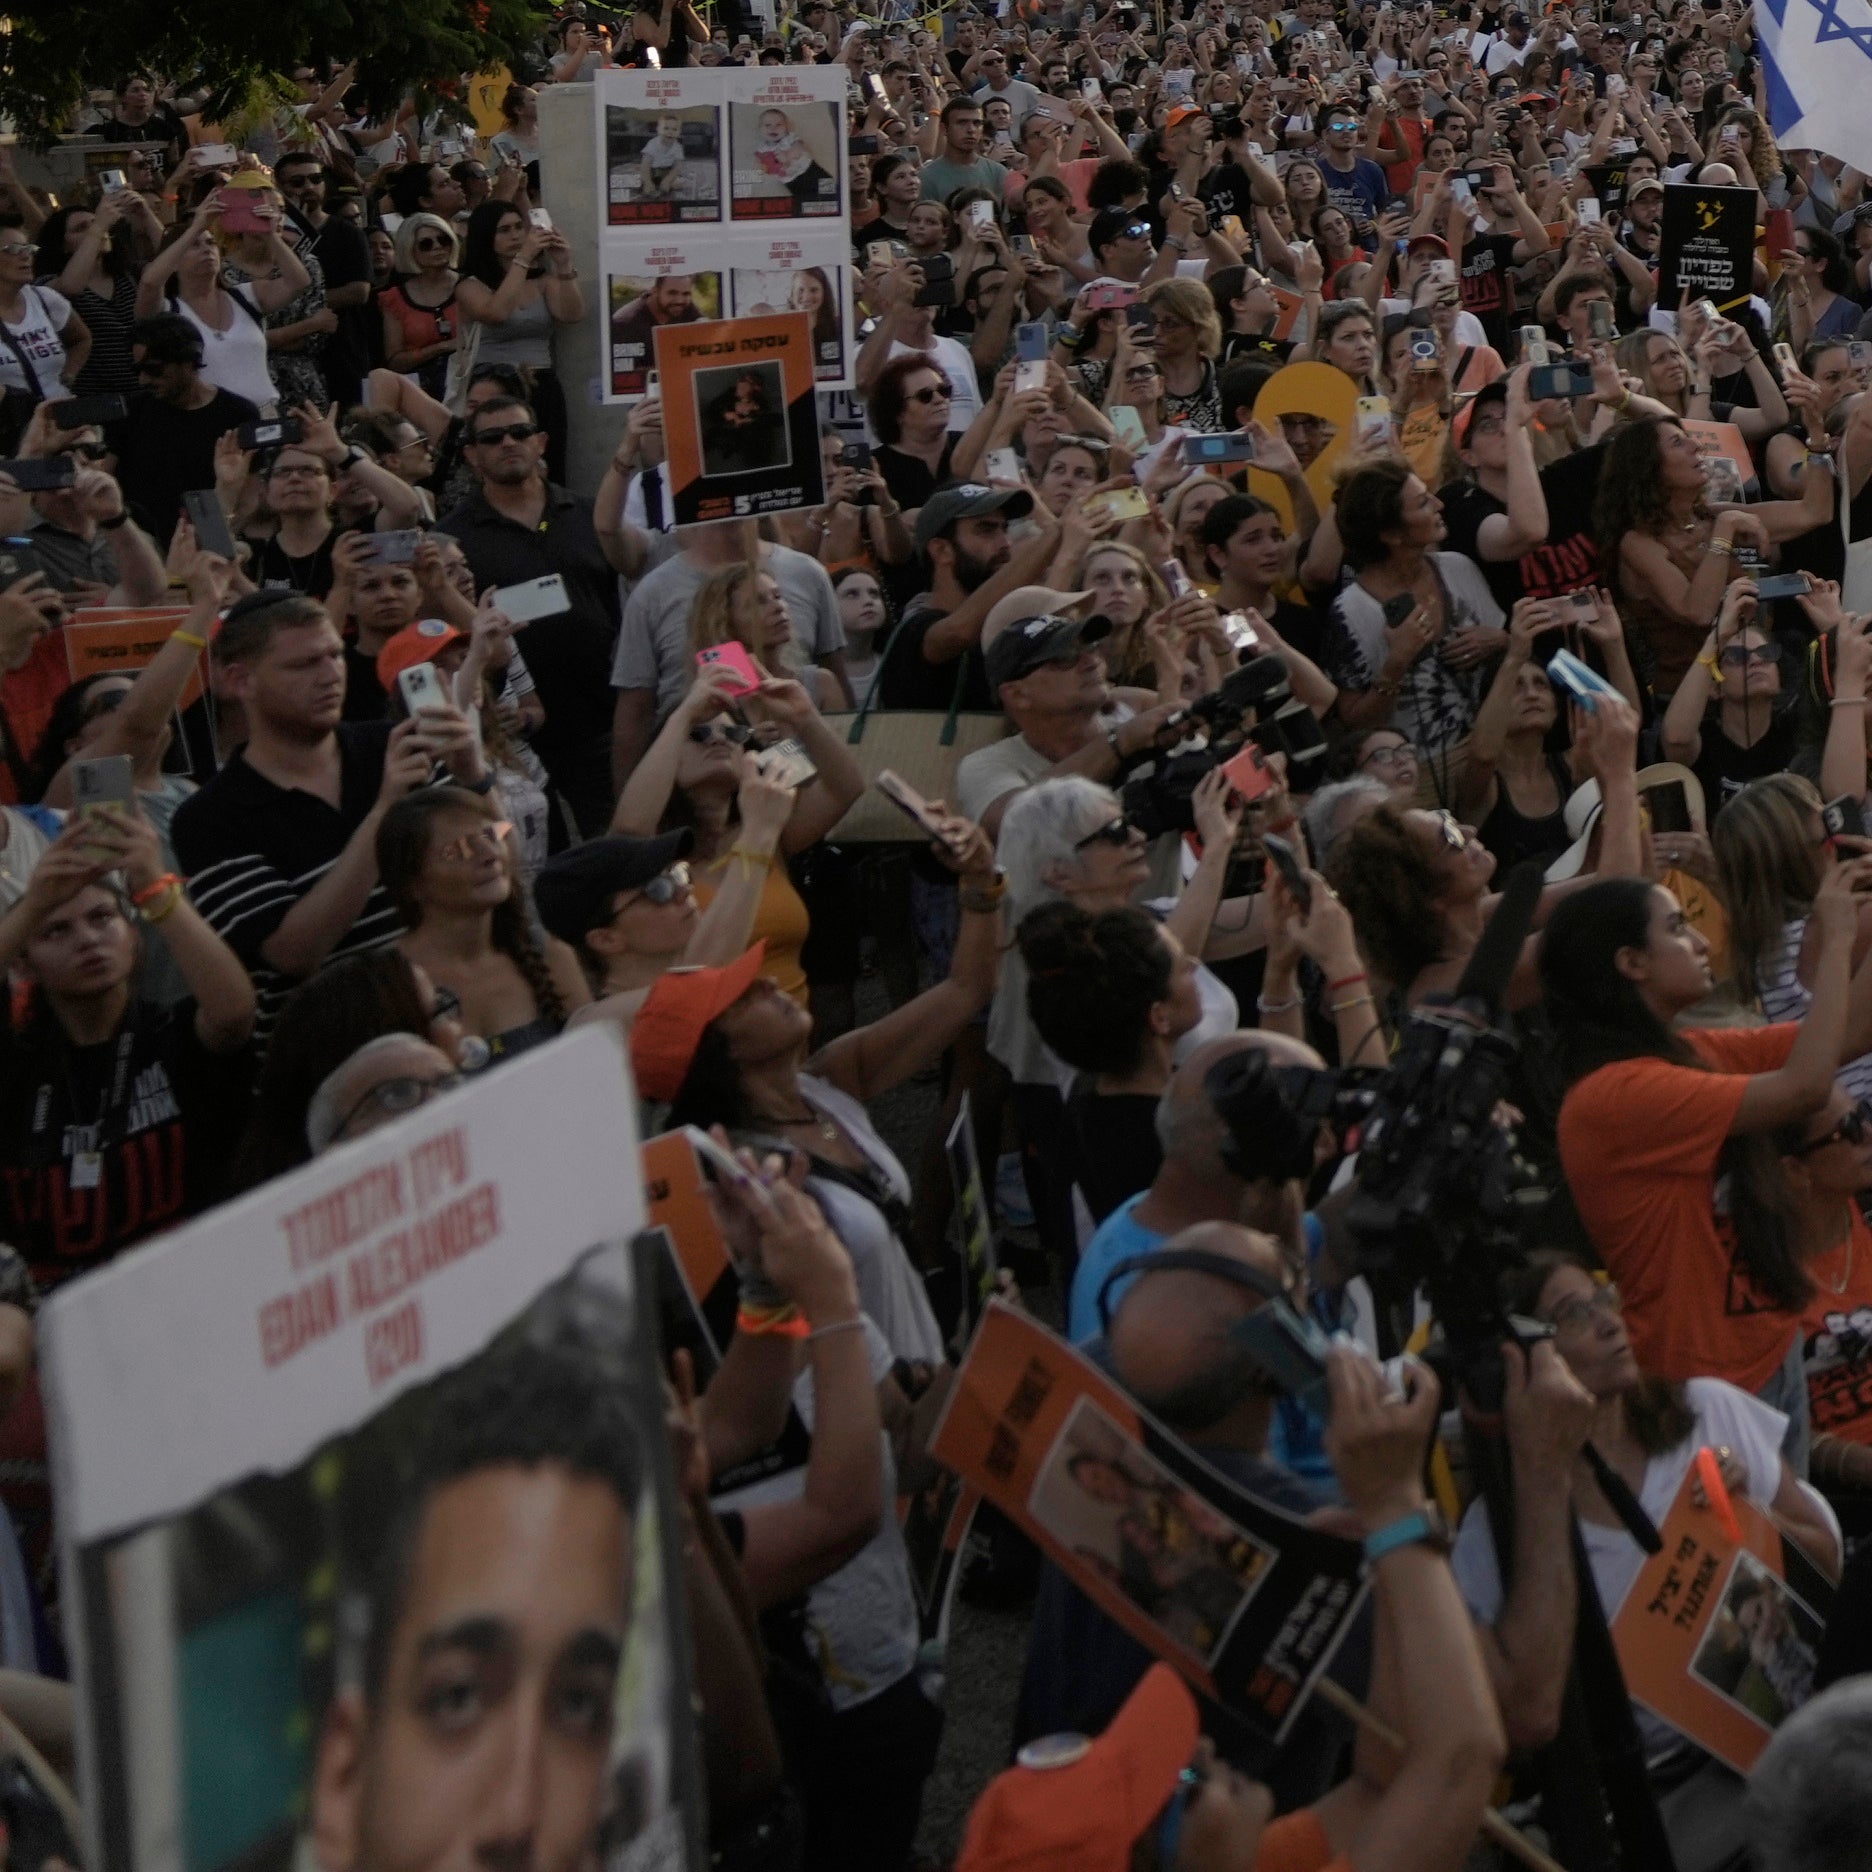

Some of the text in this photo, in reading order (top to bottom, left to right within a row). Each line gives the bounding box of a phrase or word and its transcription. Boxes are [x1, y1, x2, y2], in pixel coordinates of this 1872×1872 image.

[680, 334, 789, 359] עסקה עכשיו!
[734, 495, 752, 516] 5
[1647, 1534, 1698, 1616] מי יציל
